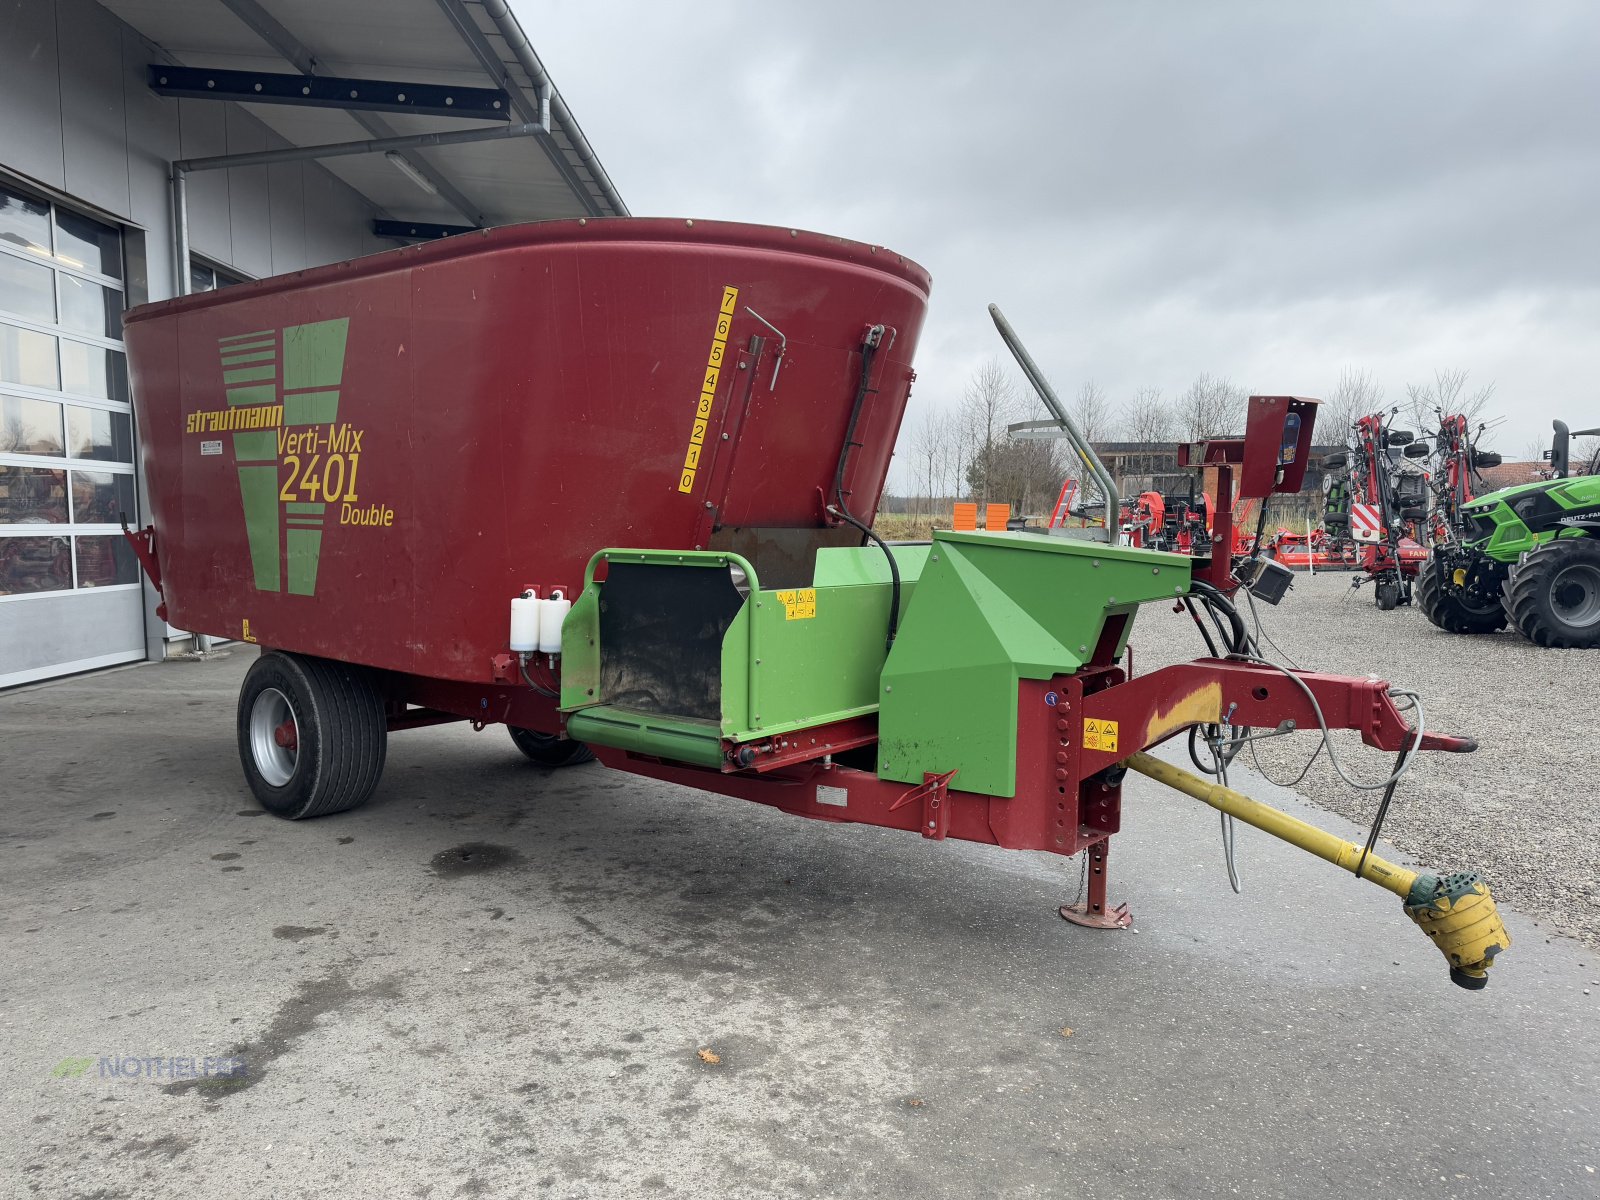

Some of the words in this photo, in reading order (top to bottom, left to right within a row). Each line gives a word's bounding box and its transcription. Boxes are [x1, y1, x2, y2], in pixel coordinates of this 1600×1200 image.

[725, 293, 735, 307] 7
[718, 320, 728, 334] 6
[712, 347, 721, 360] 5
[706, 374, 715, 387] 4
[700, 400, 709, 412] 3
[187, 405, 283, 433] strautmann
[694, 426, 703, 438] 2
[277, 424, 364, 454] Verti-Mix
[690, 451, 697, 463] 1
[279, 454, 359, 502] 2401
[682, 475, 691, 488] 0
[340, 503, 394, 527] Double
